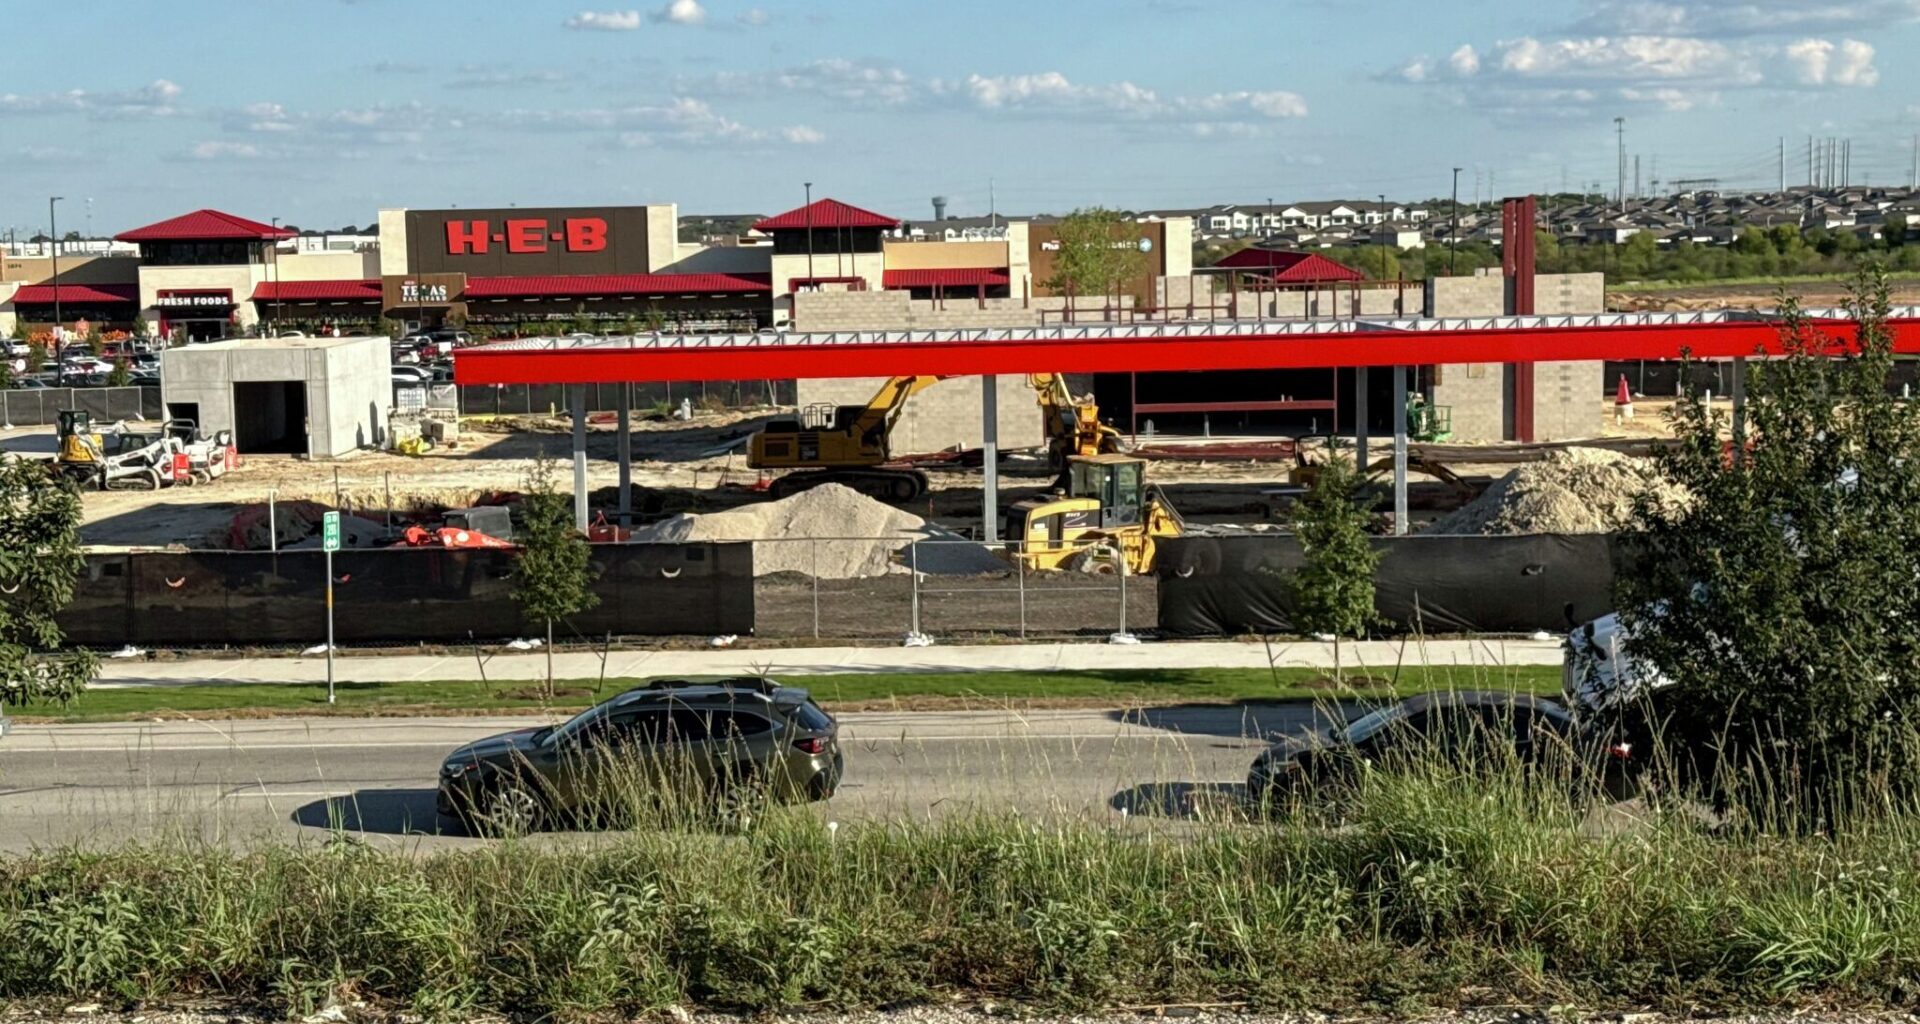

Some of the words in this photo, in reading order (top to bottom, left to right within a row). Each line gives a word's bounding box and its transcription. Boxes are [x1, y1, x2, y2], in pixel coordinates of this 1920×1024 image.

[445, 217, 608, 255] H-E-B
[401, 285, 447, 296] TEXAS
[158, 297, 191, 305] FRESH
[193, 296, 229, 306] FOODS
